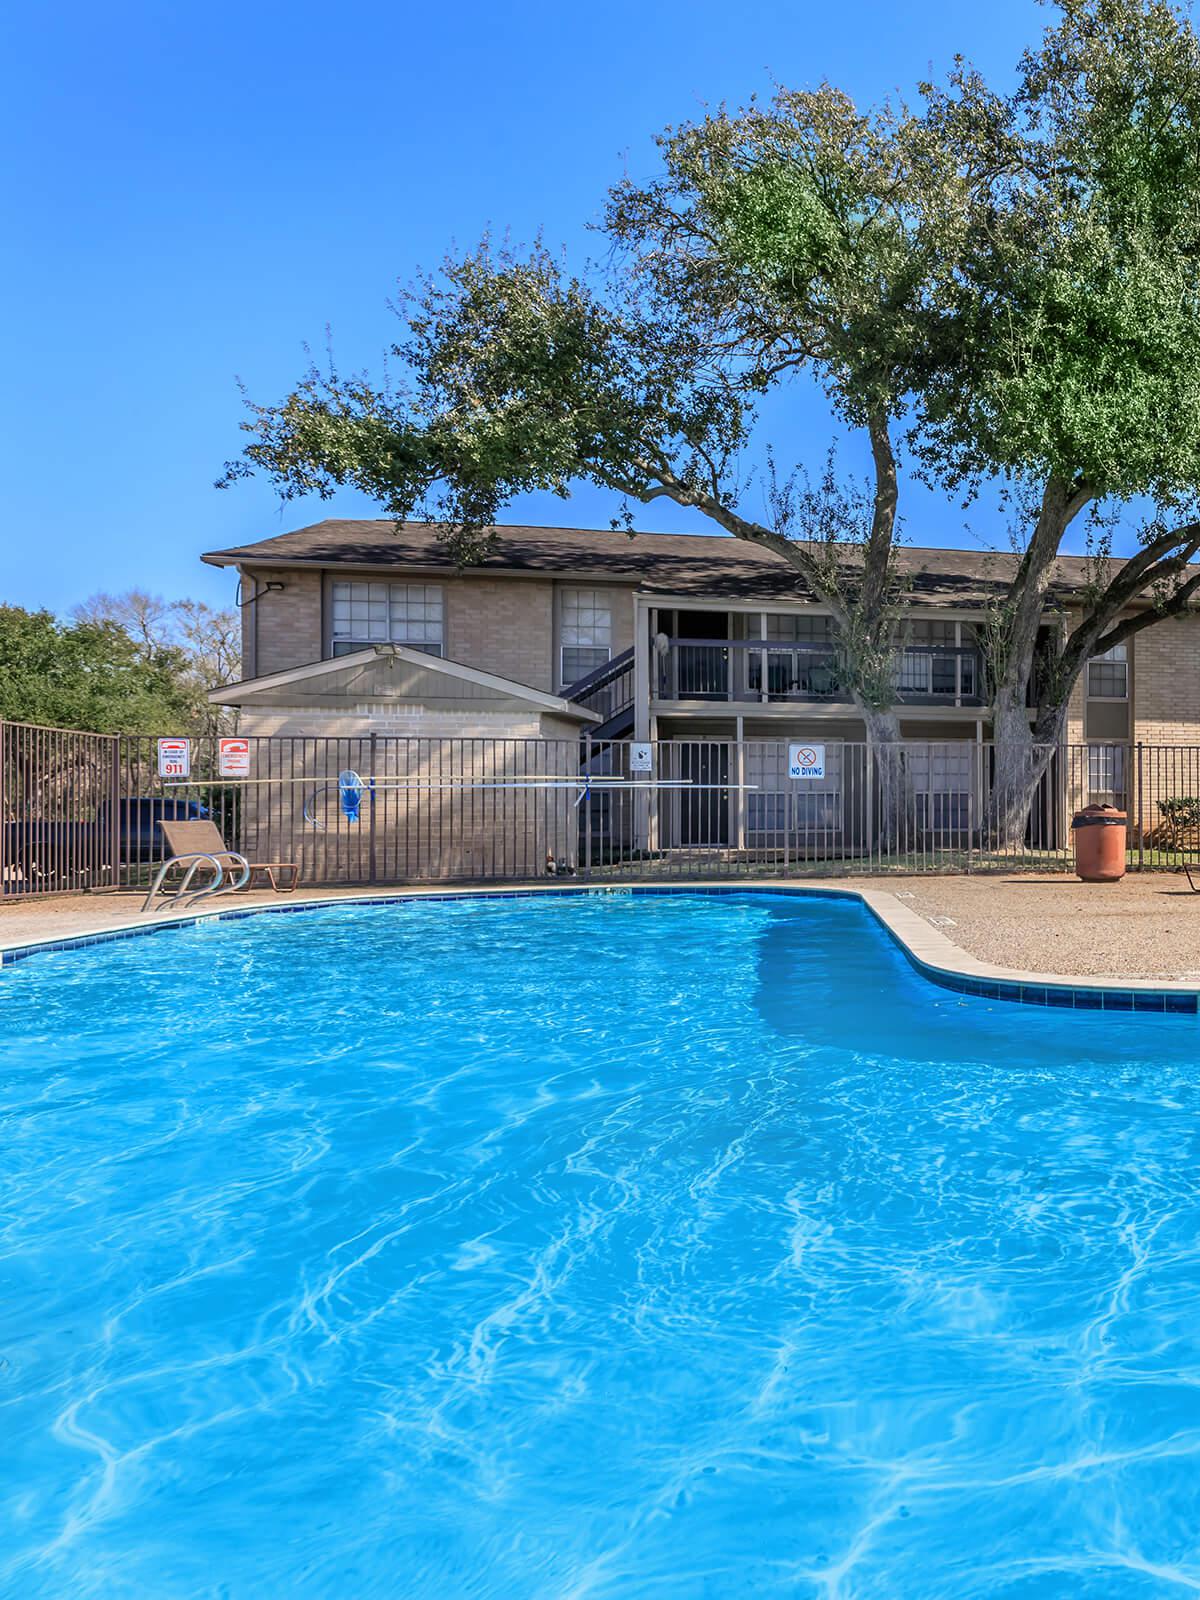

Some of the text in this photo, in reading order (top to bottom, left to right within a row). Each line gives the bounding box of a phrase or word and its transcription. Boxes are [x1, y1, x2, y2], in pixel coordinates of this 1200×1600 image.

[165, 763, 183, 774] 911
[791, 766, 823, 776] NO DIVING
